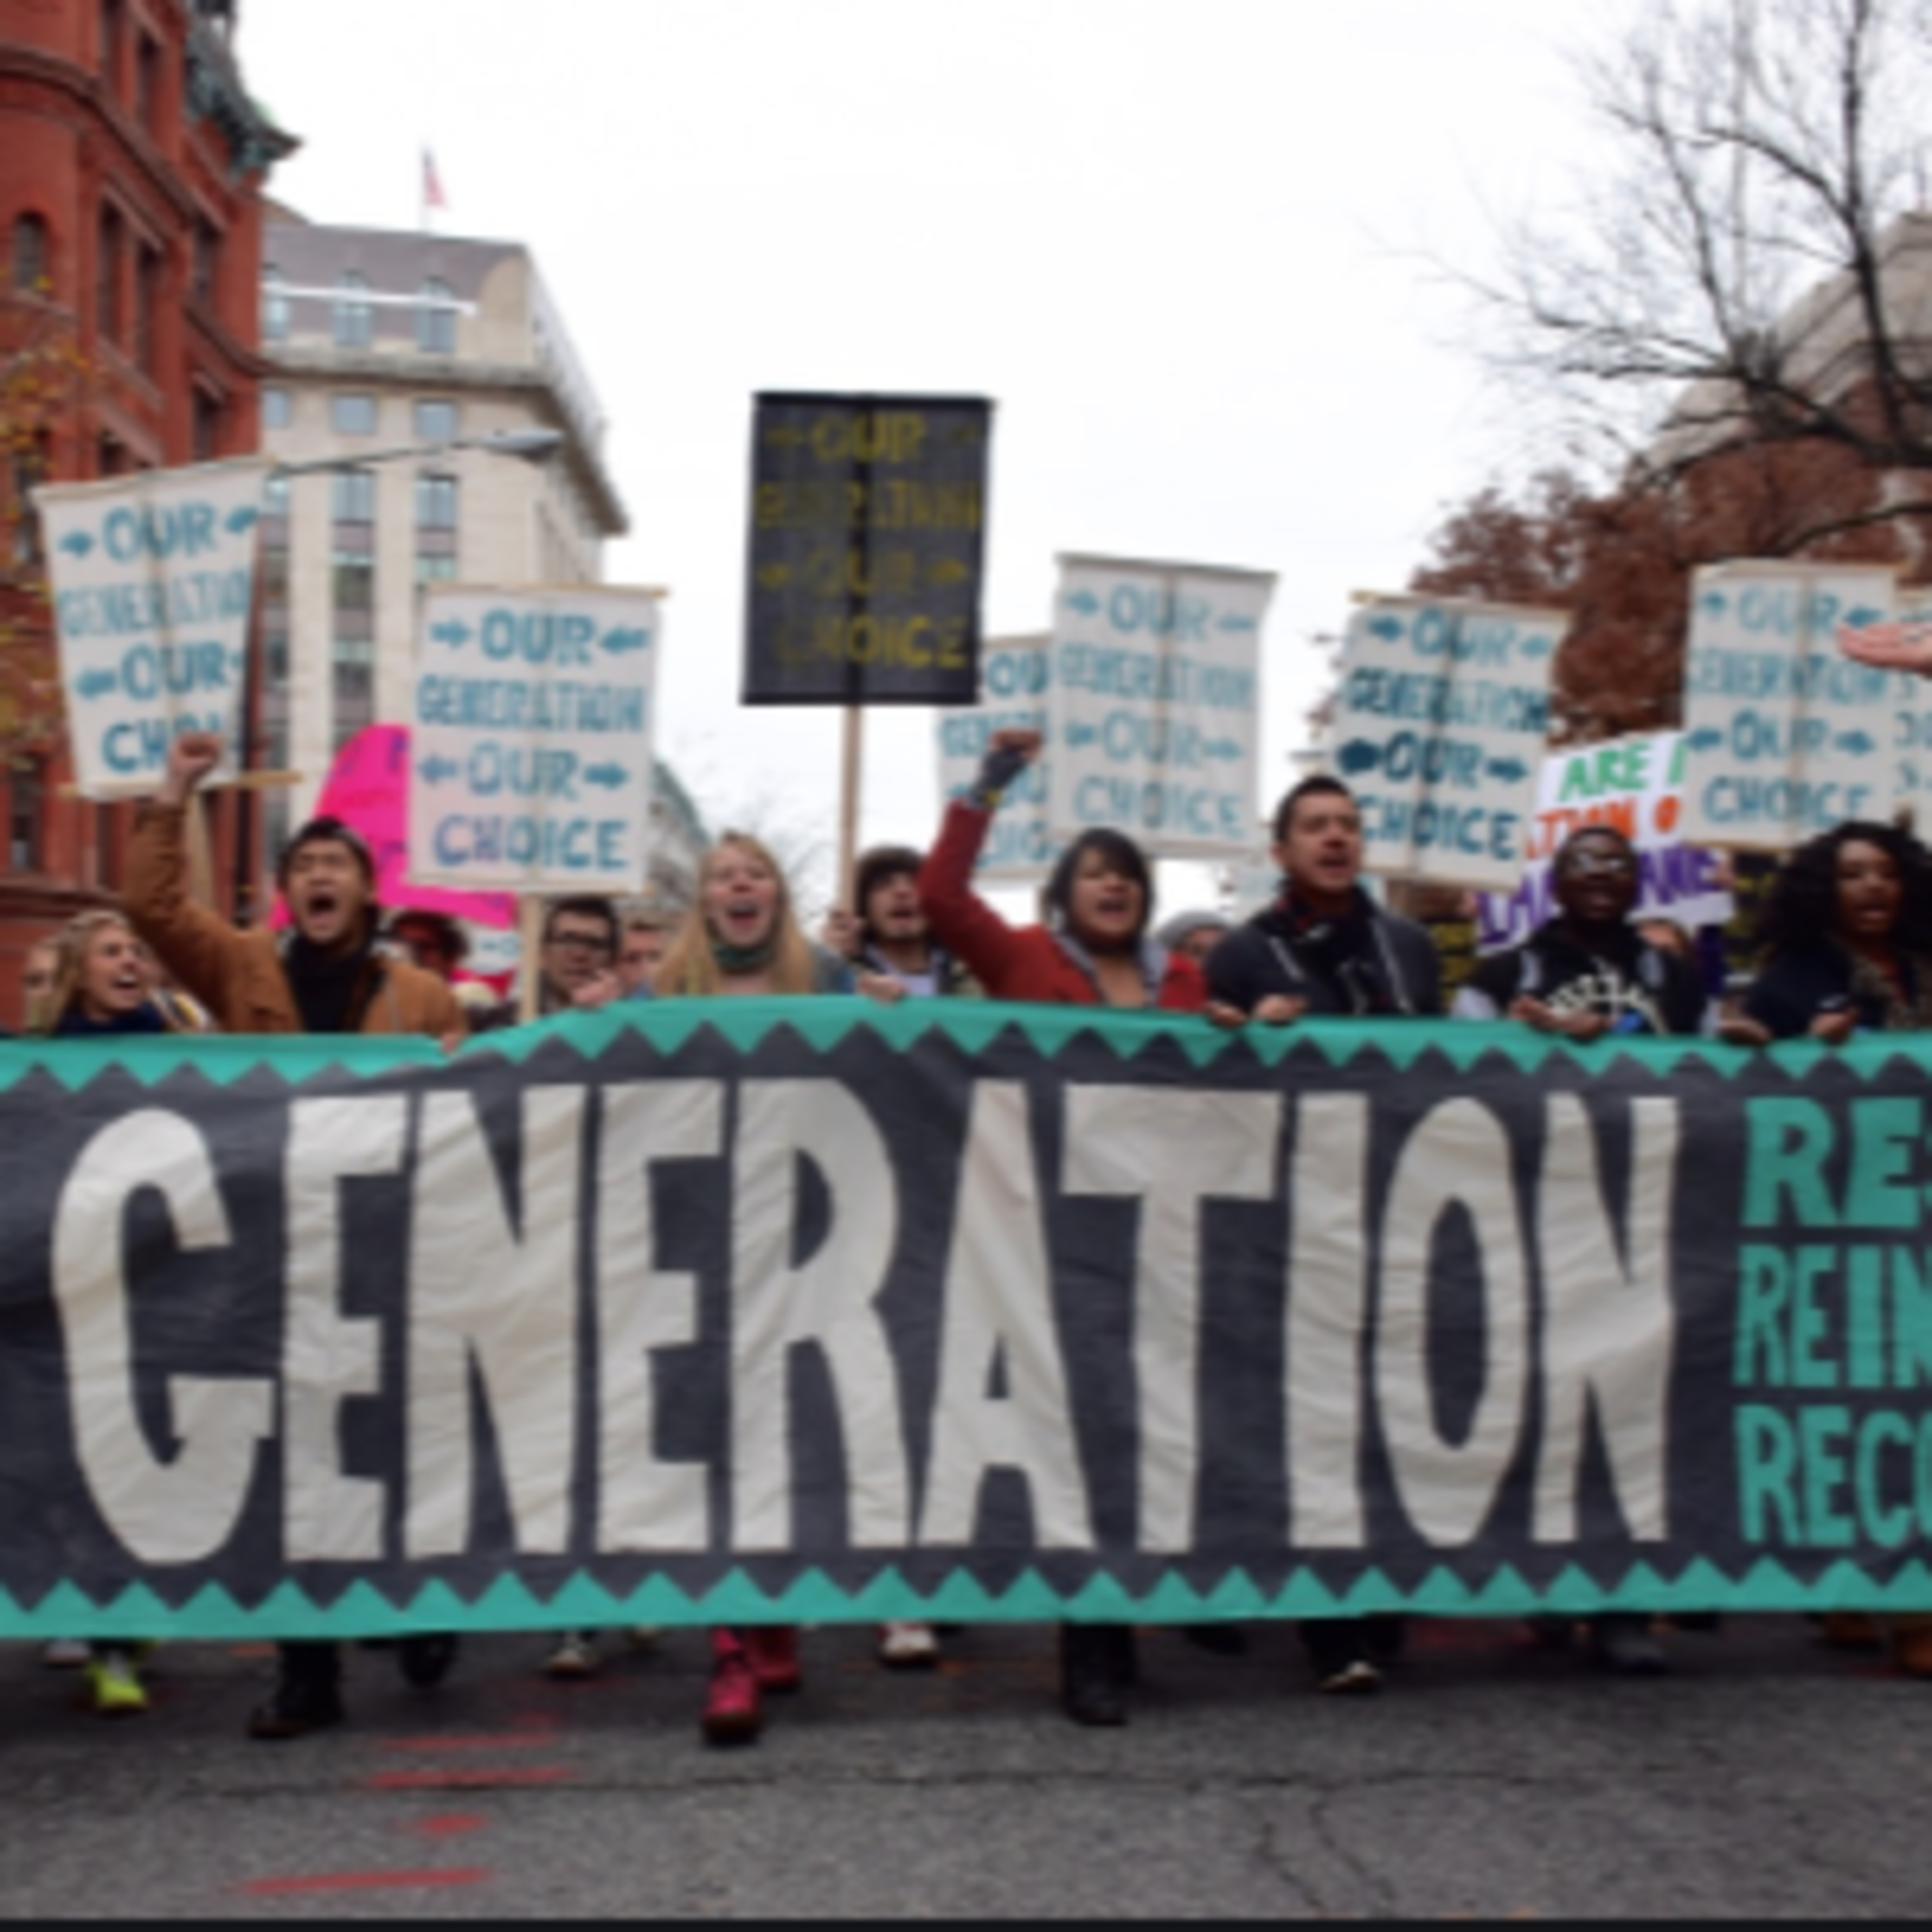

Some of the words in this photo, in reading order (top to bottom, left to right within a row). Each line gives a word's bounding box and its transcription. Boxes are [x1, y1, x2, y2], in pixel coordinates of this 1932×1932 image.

[808, 411, 929, 464] OUR
[103, 501, 216, 564] OUR
[479, 608, 598, 667] OUR
[1109, 582, 1212, 643] OUR
[1410, 607, 1519, 667] OUR
[1740, 585, 1841, 639] OUR
[119, 639, 229, 702] OUR
[416, 672, 644, 734] GENERATION
[1103, 710, 1202, 770] OUR
[1382, 729, 1485, 790] OUR
[1731, 706, 1829, 764] OUR
[468, 741, 580, 802] OUR
[1558, 741, 1653, 802] ARE
[1072, 774, 1247, 841] CHOICE
[431, 813, 630, 871] CHOICE
[1740, 1095, 1932, 1227] RE
[52, 1078, 1681, 1565] GENERATION
